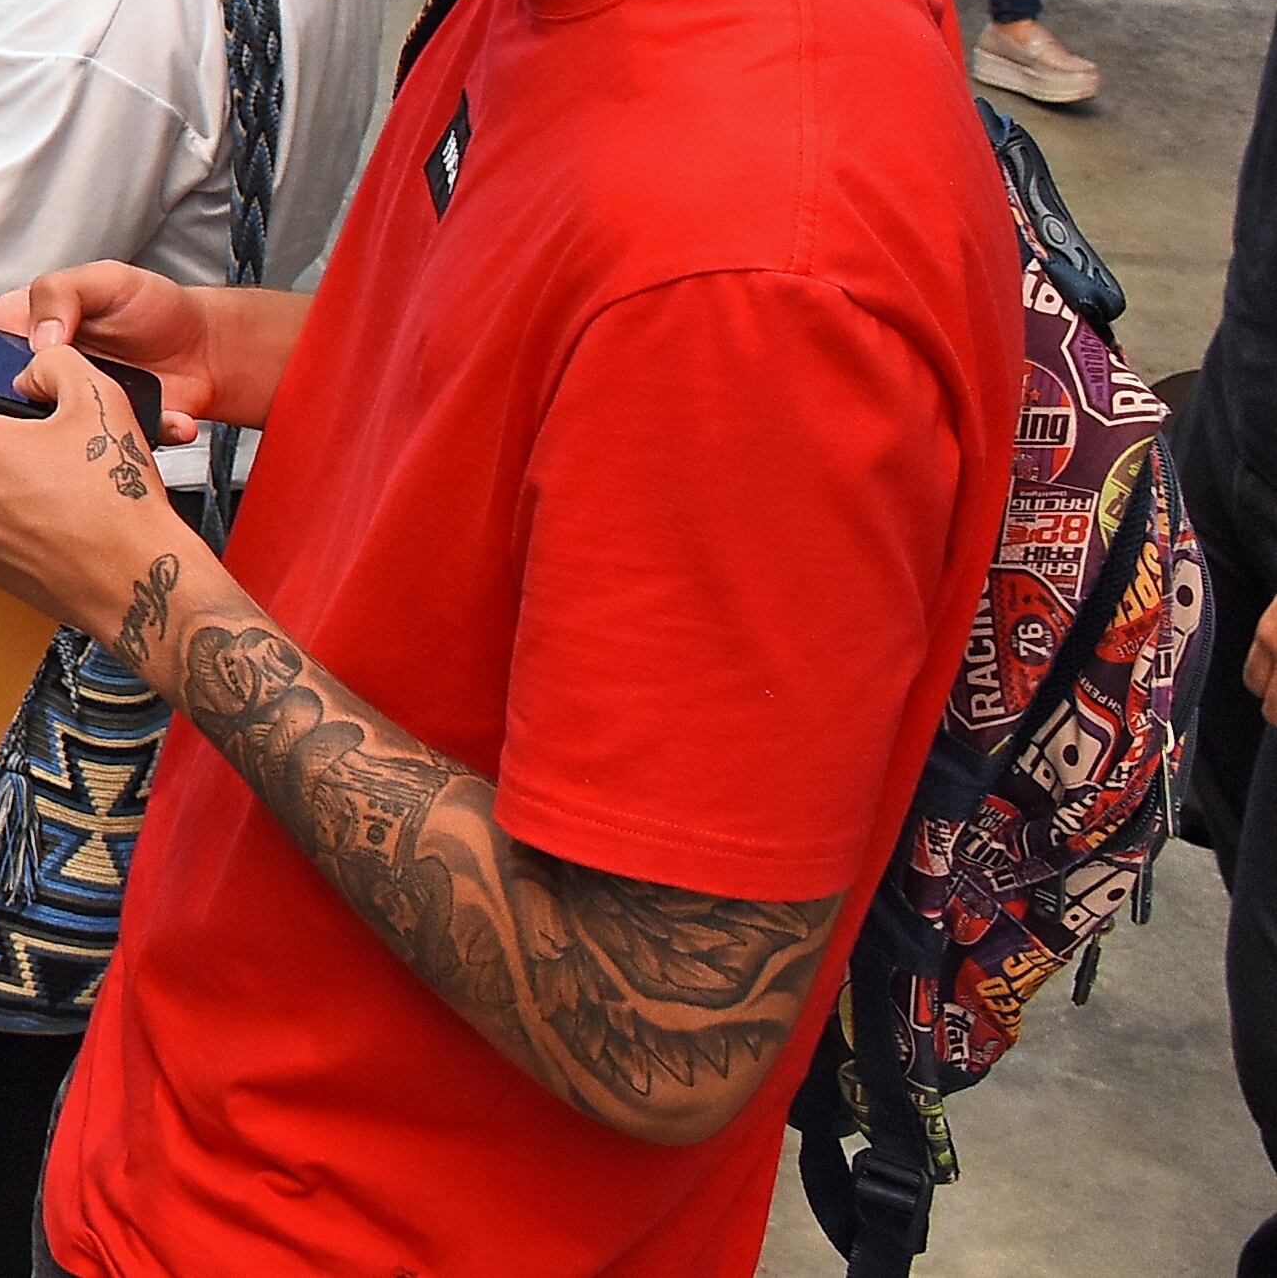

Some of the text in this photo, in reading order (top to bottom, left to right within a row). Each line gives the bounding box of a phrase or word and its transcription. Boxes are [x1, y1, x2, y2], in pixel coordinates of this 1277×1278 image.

[1011, 498, 1092, 512] RACING
[1035, 514, 1090, 545] 82
[1017, 623, 1049, 657] 76
